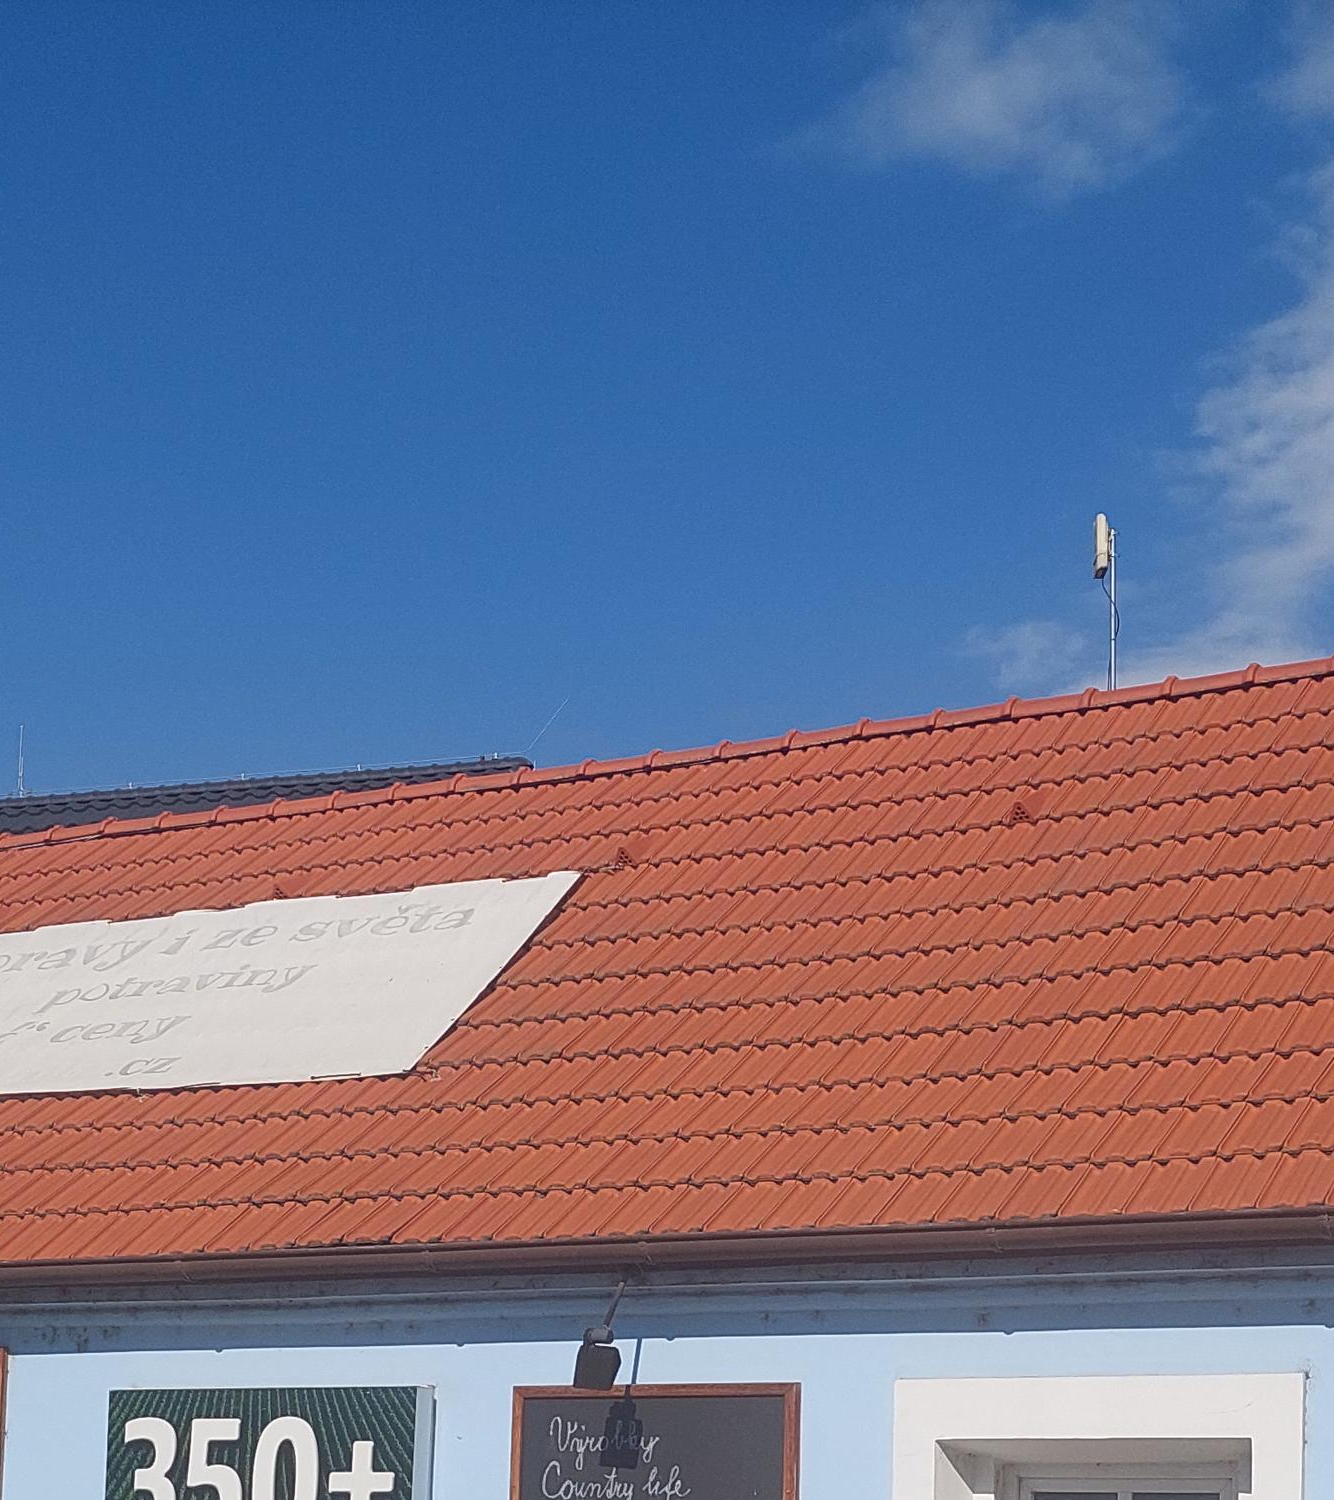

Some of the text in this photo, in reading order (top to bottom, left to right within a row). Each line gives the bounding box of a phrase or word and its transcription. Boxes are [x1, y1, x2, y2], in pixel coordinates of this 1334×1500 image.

[201, 925, 278, 952] ze
[289, 902, 476, 942] světa
[33, 963, 317, 1015] potraviny
[50, 1015, 192, 1046] ceny
